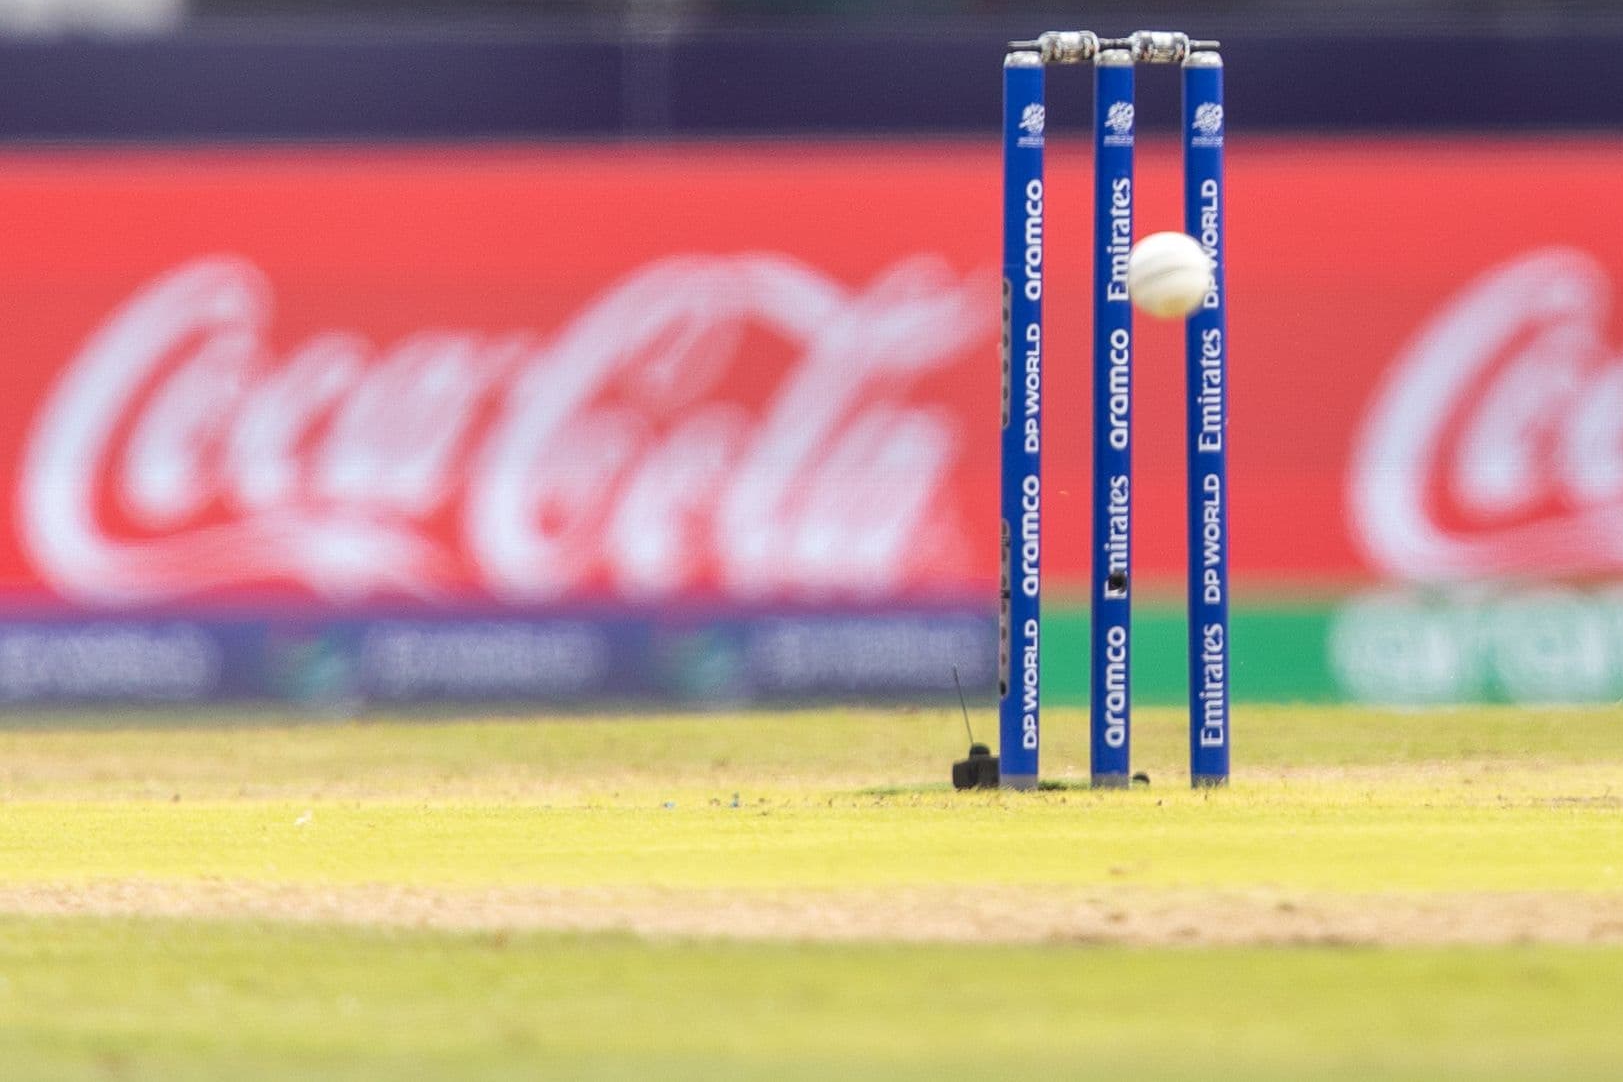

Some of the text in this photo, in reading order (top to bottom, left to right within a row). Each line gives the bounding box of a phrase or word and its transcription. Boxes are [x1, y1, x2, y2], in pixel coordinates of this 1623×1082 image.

[1025, 178, 1043, 302] aramco
[1107, 177, 1130, 302] Emirates
[1025, 323, 1041, 453] DP WORLD
[1109, 328, 1129, 450] aramco
[1198, 327, 1223, 453] Emirates
[1023, 474, 1040, 598] aramco
[1204, 472, 1221, 605] DP WORLD
[1023, 619, 1038, 750] DP WORLD
[1105, 625, 1126, 748] aramco
[1199, 622, 1224, 748] Emirates
